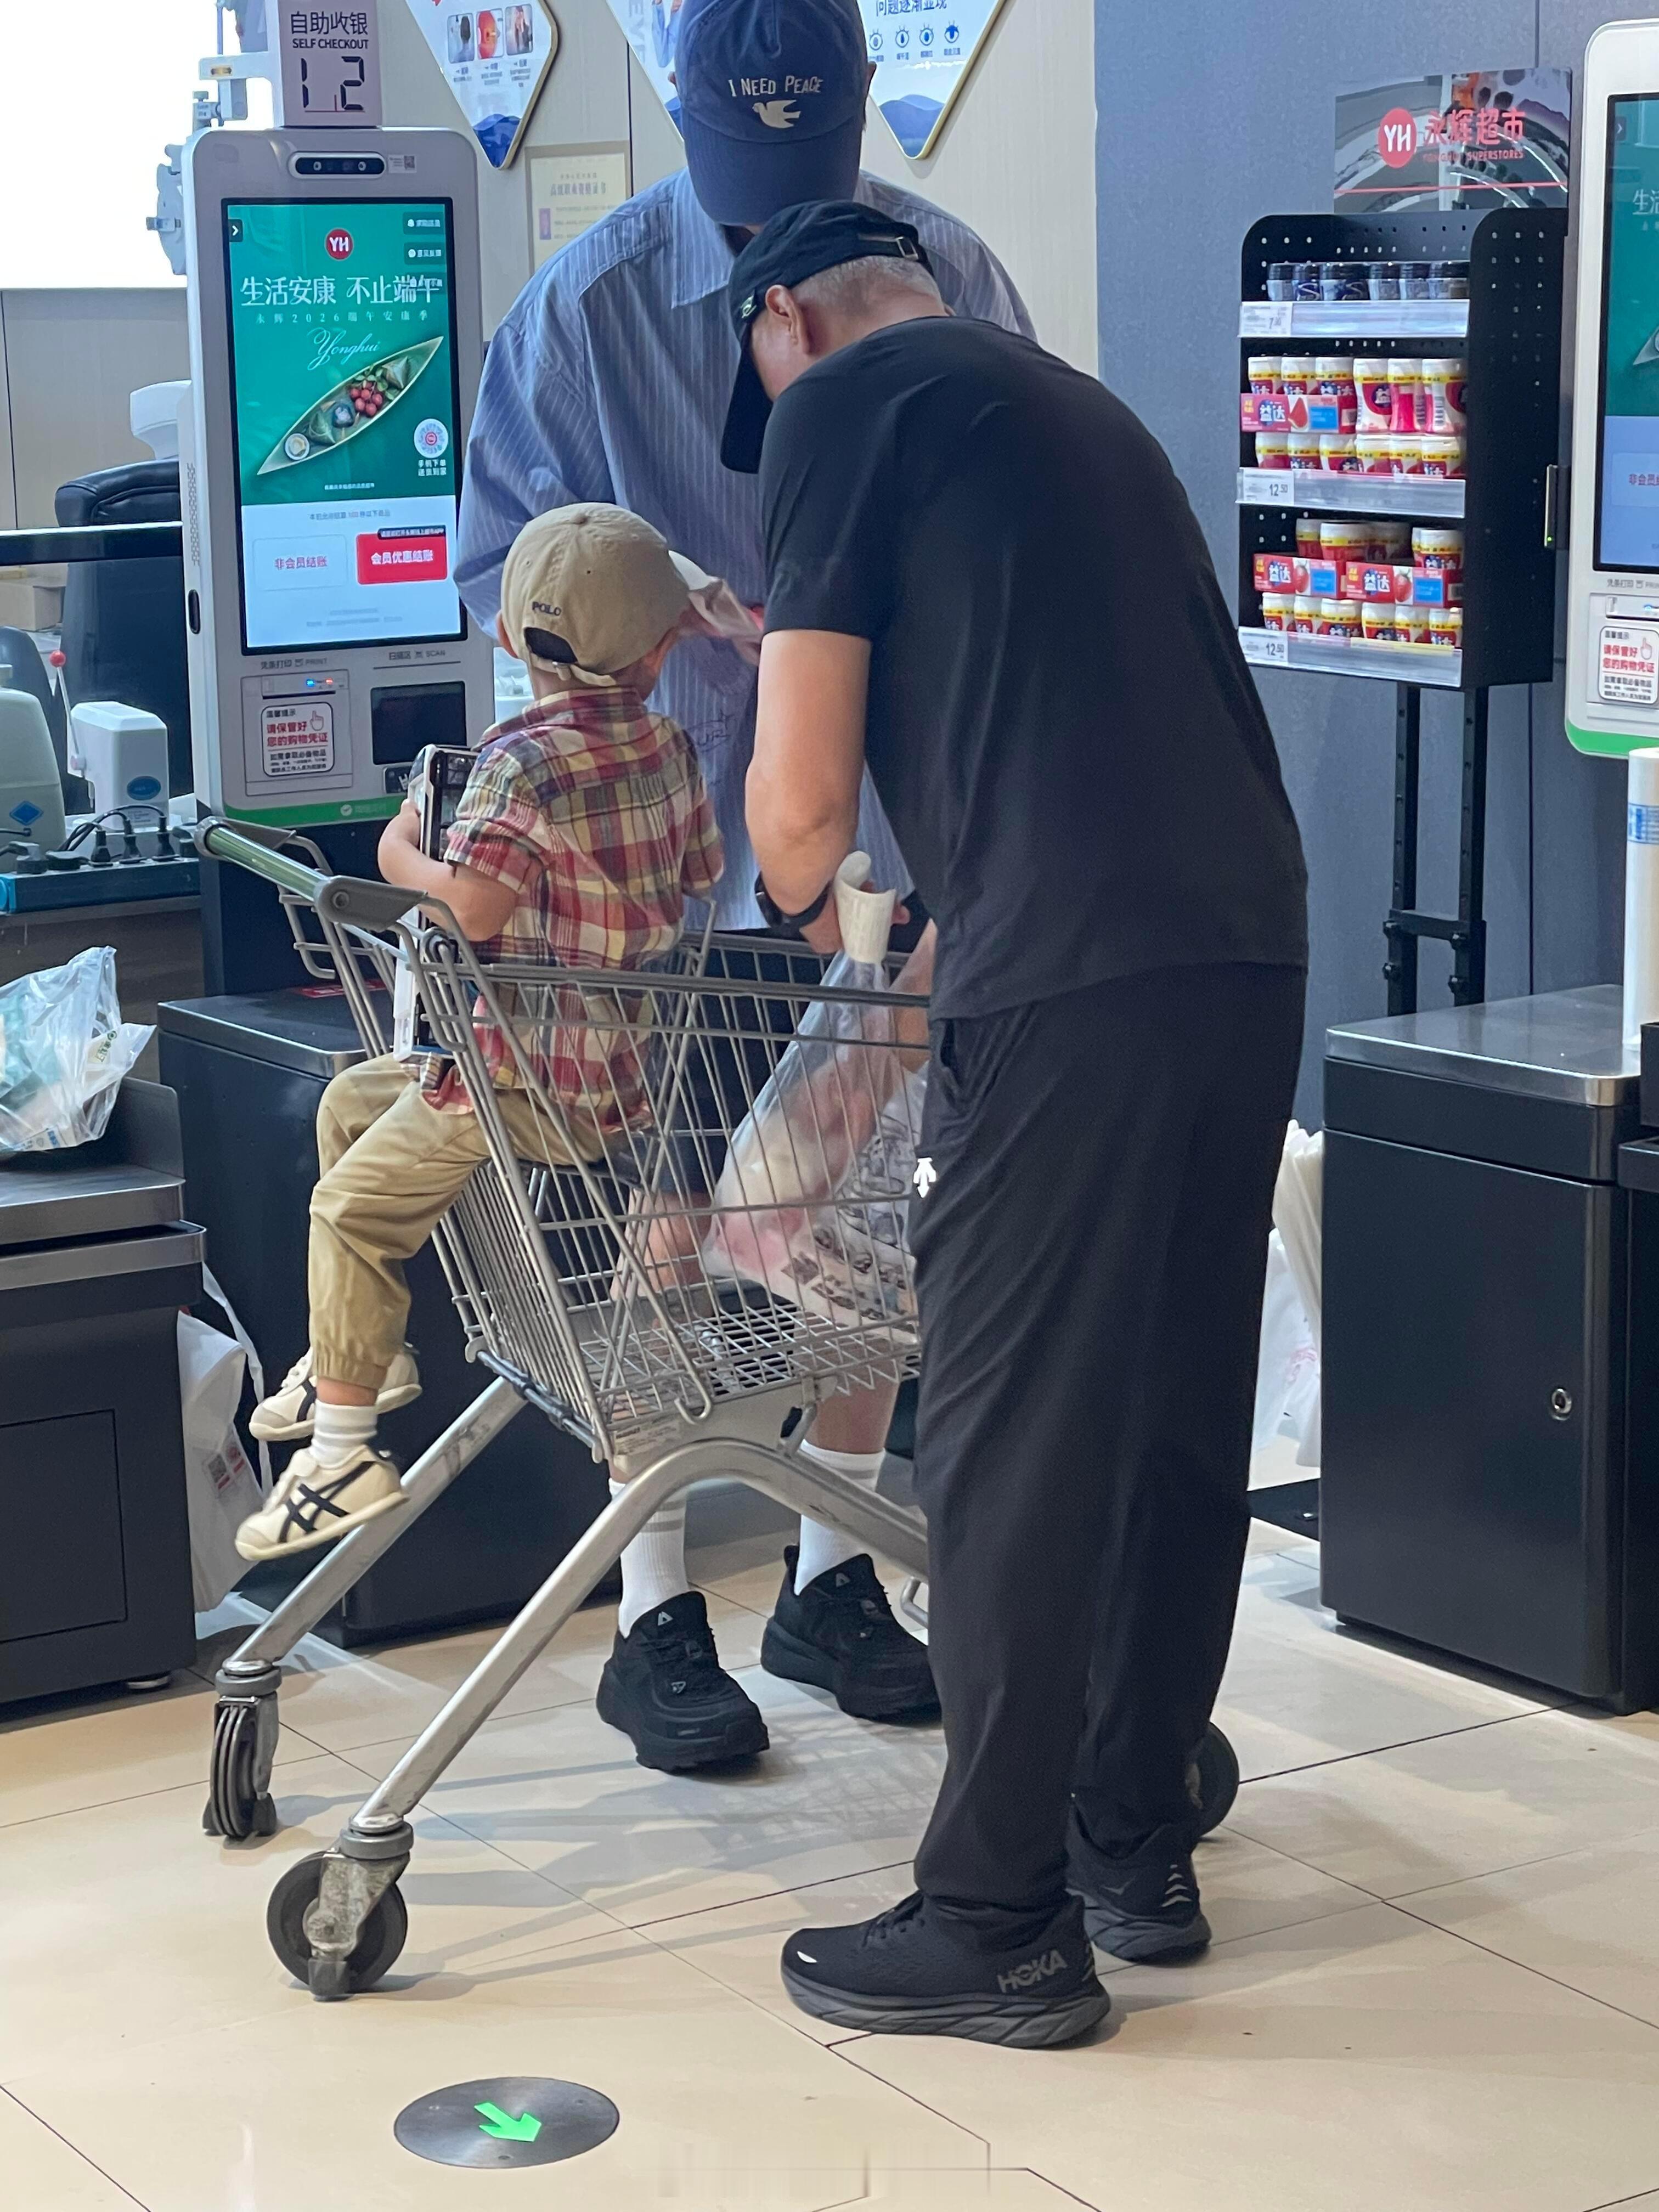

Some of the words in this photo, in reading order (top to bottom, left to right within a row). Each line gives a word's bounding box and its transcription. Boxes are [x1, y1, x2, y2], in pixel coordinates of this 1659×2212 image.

[291, 11, 368, 35] 自助收银
[292, 38, 316, 48] SELF
[318, 39, 368, 49] CHECKOUT
[301, 56, 365, 110] 12
[728, 79, 737, 97] I
[741, 78, 776, 95] NEED
[785, 75, 823, 93] PEACE
[1424, 107, 1526, 145] 永辉超市
[1384, 123, 1412, 153] YH
[1467, 149, 1524, 161] SUPERSTORES
[329, 236, 349, 252] YH
[240, 275, 336, 306] 生活安康
[346, 274, 440, 304] 不止端午
[307, 328, 380, 370] Yonghui
[1260, 405, 1286, 422] 益达
[275, 556, 328, 570] 非会员结账
[371, 549, 433, 565] 会员优惠结账
[1269, 565, 1291, 583] 益达
[1364, 573, 1390, 592] 益达
[532, 601, 562, 616] POLO
[1604, 644, 1638, 657] 请保管好
[1603, 657, 1655, 673] 您的购物凭证
[267, 721, 307, 733] 请保管好
[267, 732, 328, 747] 您的购物凭证
[997, 1949, 1068, 1993] HOKA
